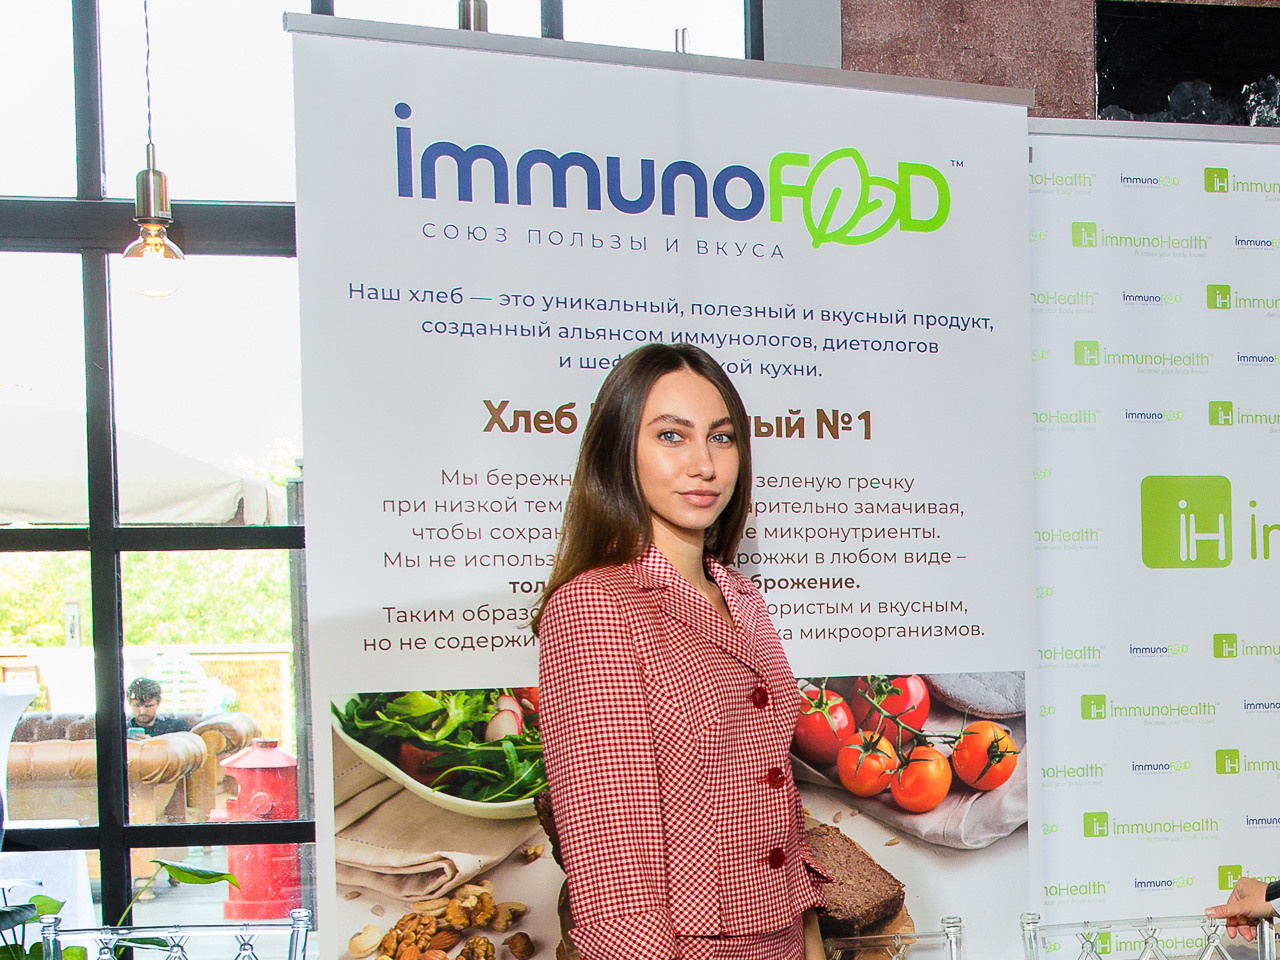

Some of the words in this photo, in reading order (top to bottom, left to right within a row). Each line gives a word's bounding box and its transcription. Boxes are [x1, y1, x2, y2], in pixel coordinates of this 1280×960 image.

[421, 222, 508, 243] СОЮЗ
[527, 229, 648, 251] ПОЛЬЗЫ
[665, 237, 679, 252] И
[697, 239, 784, 259] ВКУСА
[348, 283, 400, 301] Наш
[409, 287, 464, 304] хлеб
[499, 293, 535, 307] это
[542, 294, 684, 317] уникальный,
[691, 302, 796, 320] полезный
[803, 310, 814, 320] и
[821, 309, 907, 326] вкусный
[914, 313, 994, 333] продукт,
[422, 319, 550, 337] созданный
[558, 324, 663, 342] альянсом
[671, 331, 817, 351] иммунологов,
[823, 337, 938, 354] диетологов
[559, 356, 571, 368] и
[761, 362, 822, 378] кухни.
[483, 400, 578, 434] Хлеб
[441, 469, 478, 485] Мы
[487, 468, 573, 489] бережн
[756, 475, 841, 492] зеленую
[848, 477, 915, 492] гречку
[383, 500, 426, 516] при
[435, 497, 517, 512] низкой
[753, 501, 848, 517] рительно
[854, 502, 964, 517] замачивая,
[412, 523, 481, 540] чтобы
[490, 527, 564, 543] сохран
[764, 527, 940, 542] микронутриенты.
[384, 552, 420, 568] Мы
[429, 555, 455, 567] не
[465, 555, 555, 567] использ
[816, 552, 824, 564] в
[830, 548, 896, 564] любом
[904, 552, 951, 565] виде
[509, 581, 545, 594] тол
[751, 574, 860, 593] брожение.
[383, 607, 453, 623] Таким
[767, 601, 853, 618] ористым
[860, 602, 871, 614] и
[879, 600, 968, 616] вкусным,
[364, 638, 391, 651] но
[400, 637, 426, 649] не
[434, 634, 536, 651] содержи
[801, 624, 985, 640] микроорганизмов.
